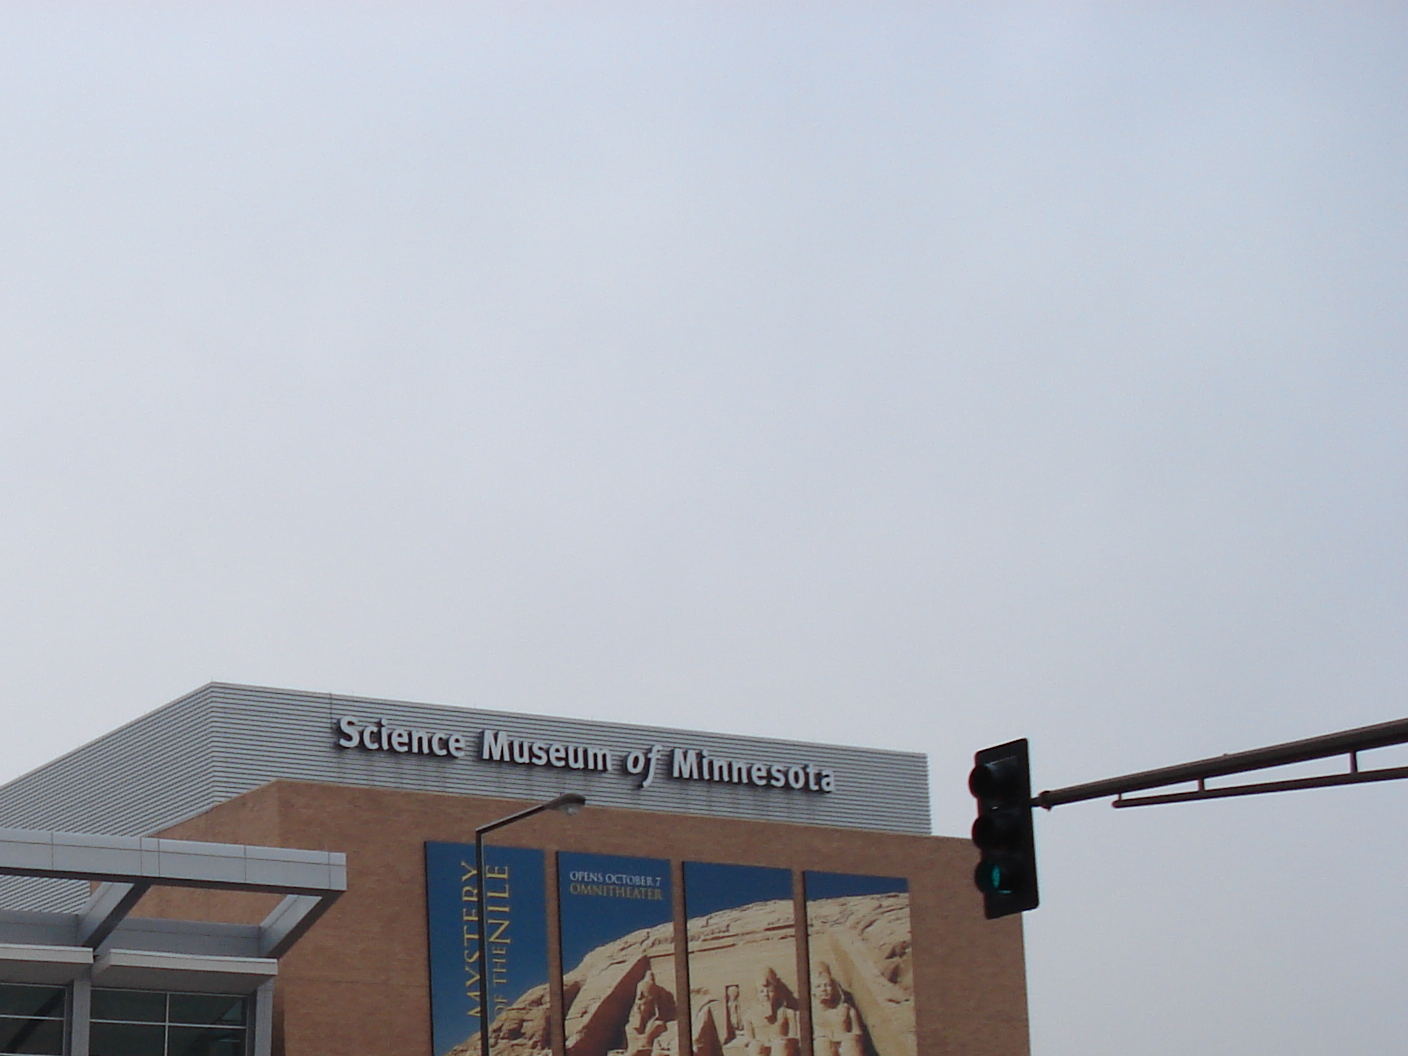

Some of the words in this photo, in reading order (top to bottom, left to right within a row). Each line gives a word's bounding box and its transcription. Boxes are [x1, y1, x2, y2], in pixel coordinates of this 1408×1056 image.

[339, 715, 466, 758] Science
[481, 729, 612, 771] Museum
[626, 744, 663, 788] of
[672, 748, 836, 792] Minnesota
[486, 865, 511, 944] NILE
[570, 871, 603, 883] OPENS
[605, 873, 654, 886] OCTOBER
[655, 877, 662, 887] 7
[570, 882, 663, 900] OMNITHEATER
[461, 861, 481, 1017] MYSTERY
[492, 946, 508, 987] THE
